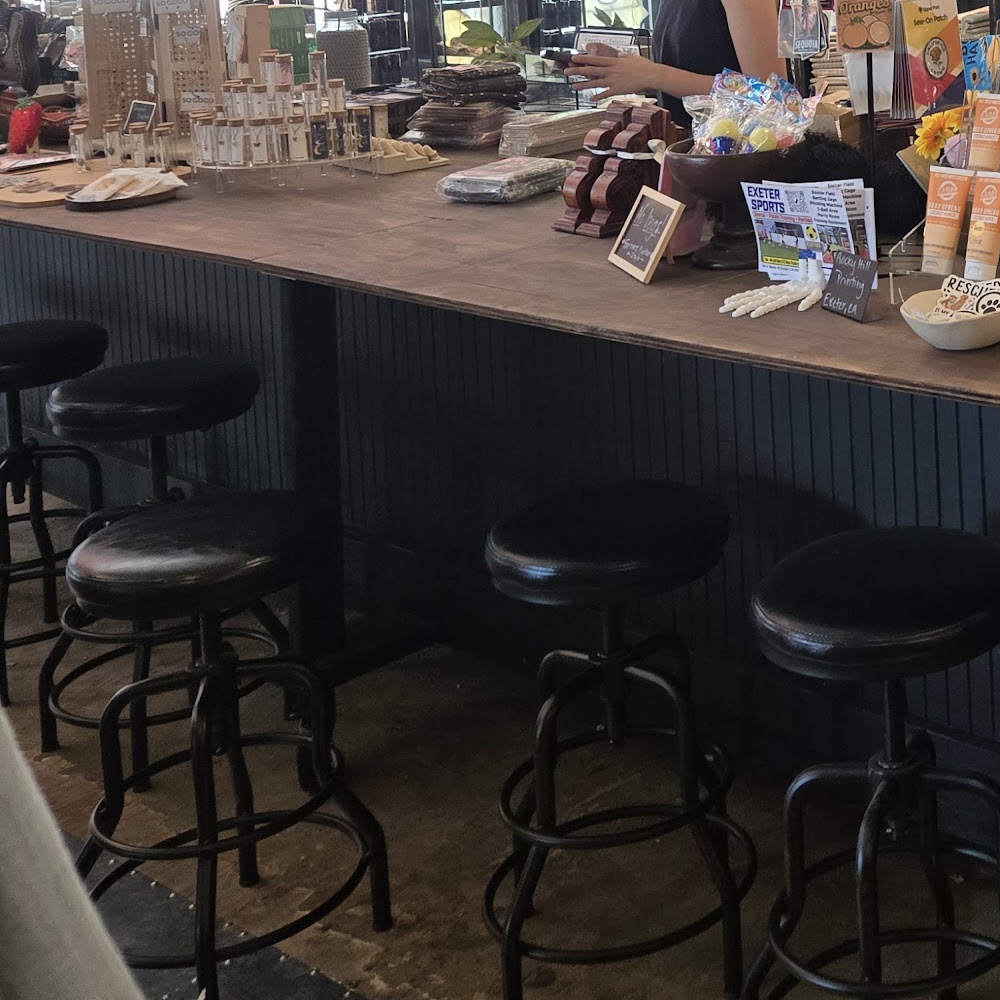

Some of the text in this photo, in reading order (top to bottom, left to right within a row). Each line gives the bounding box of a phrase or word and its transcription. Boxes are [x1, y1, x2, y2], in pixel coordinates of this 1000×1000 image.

[934, 14, 948, 22] Patch
[794, 39, 818, 49] SEQUOIA
[748, 186, 781, 200] EXETER
[751, 199, 785, 213] SPORTS
[836, 252, 871, 276] Rocky Hill
[835, 269, 865, 300] Printing
